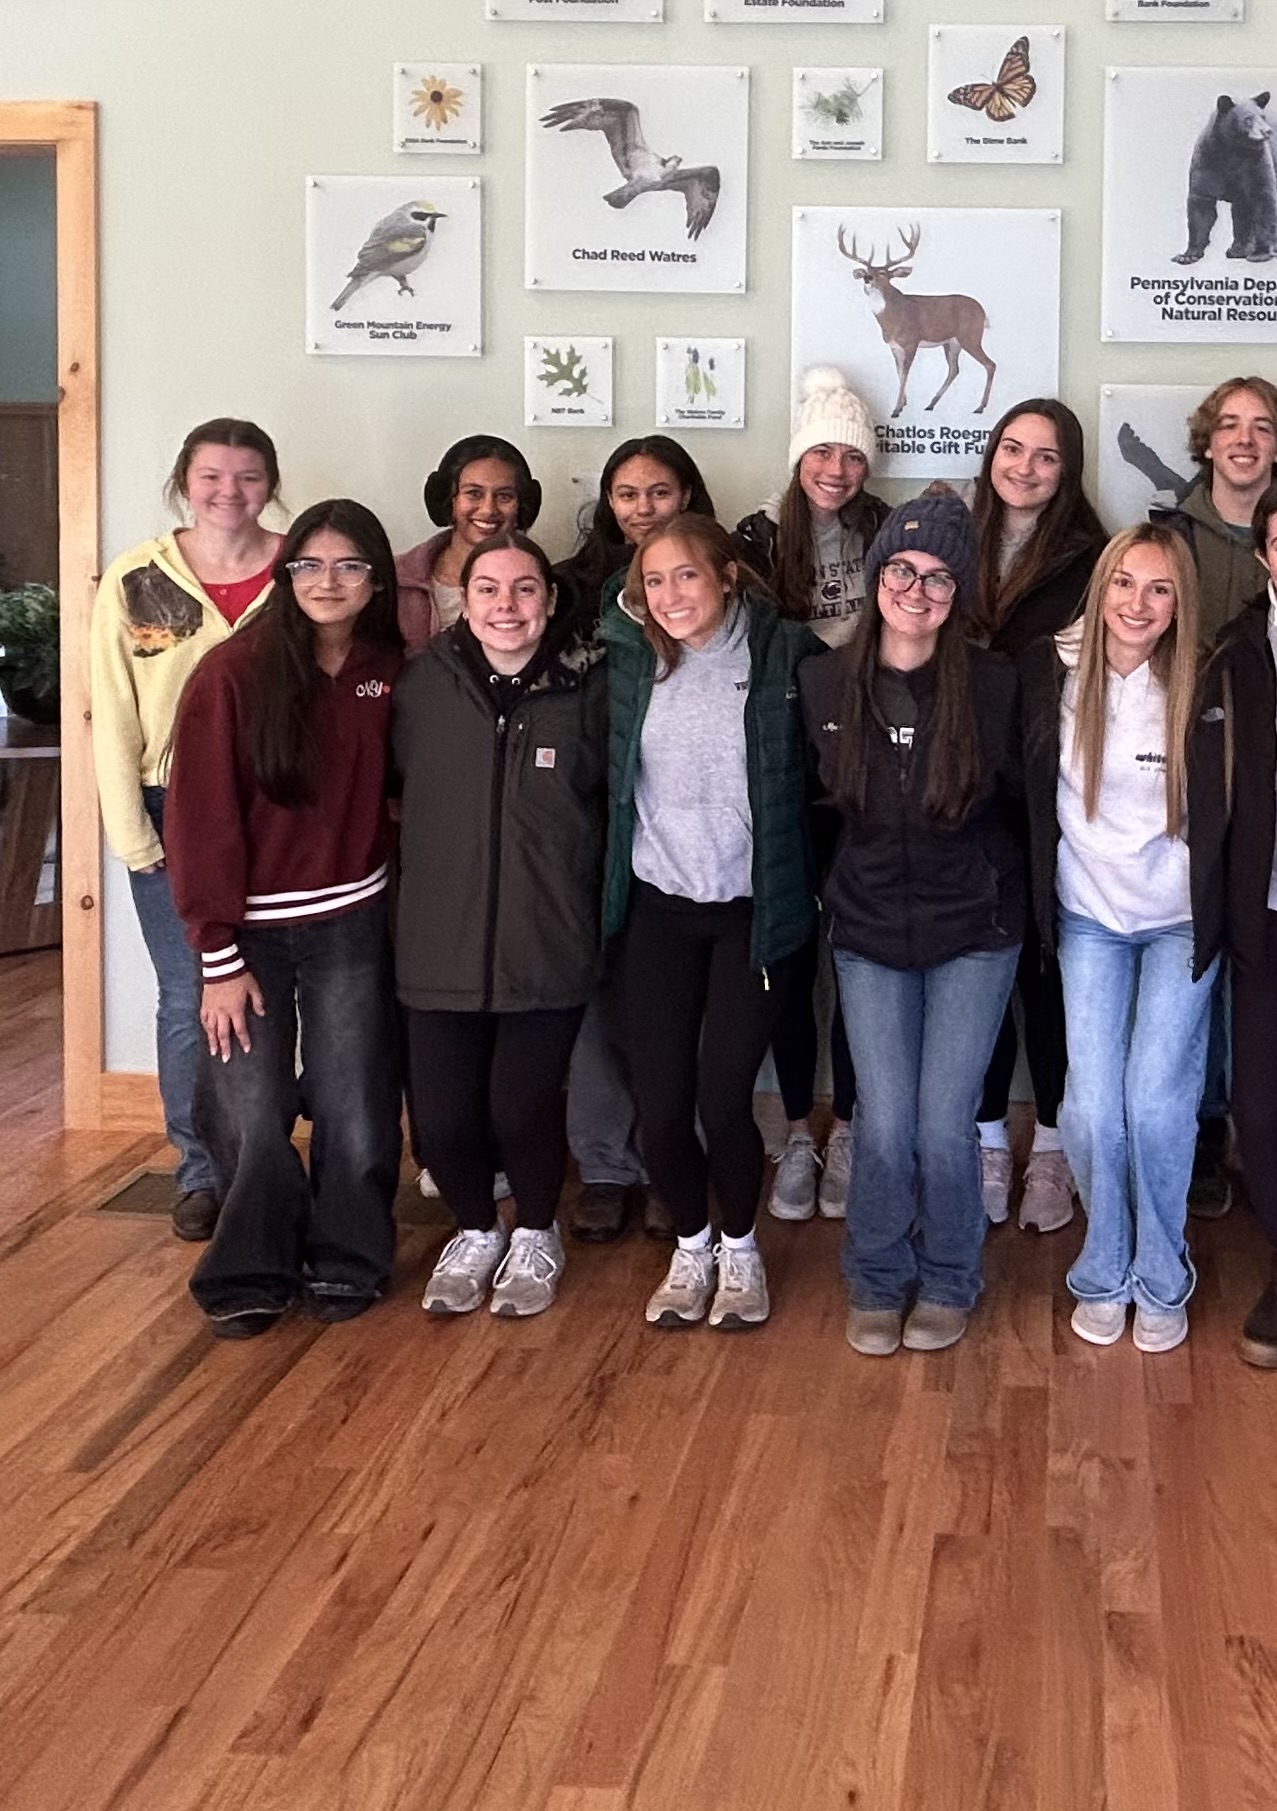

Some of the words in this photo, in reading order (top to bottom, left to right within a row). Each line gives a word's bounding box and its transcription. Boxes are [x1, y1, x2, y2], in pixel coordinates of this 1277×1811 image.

[572, 248, 608, 261] Chad
[610, 249, 646, 262] Reed
[648, 250, 698, 263] Watres
[1130, 276, 1240, 294] Pennsylvania
[1153, 291, 1171, 306] of
[1161, 307, 1222, 321] Natural
[334, 319, 365, 330] Green
[366, 320, 414, 330] Mountain
[415, 321, 452, 332] Energy
[369, 329, 390, 340] Sun
[391, 330, 418, 341] Club
[874, 425, 936, 440] Chatlos
[939, 426, 992, 442] Roegn
[929, 441, 961, 455] Gift
[964, 441, 985, 455] Fu
